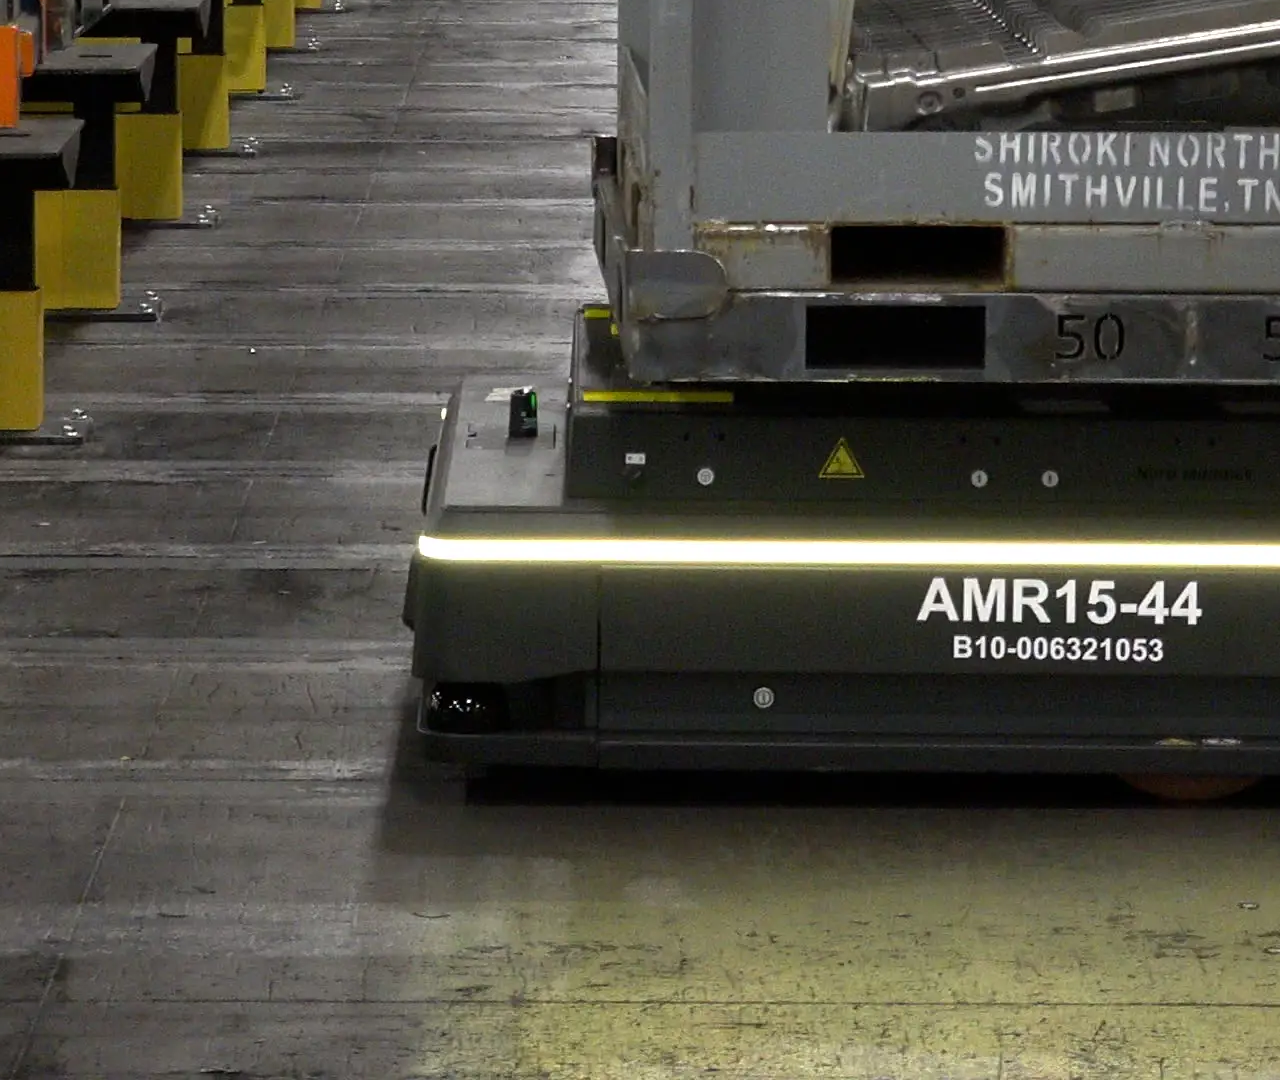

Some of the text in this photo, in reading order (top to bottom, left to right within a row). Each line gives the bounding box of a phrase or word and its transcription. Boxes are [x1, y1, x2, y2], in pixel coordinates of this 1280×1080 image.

[974, 133, 1132, 167] SHIROKI
[1148, 133, 1280, 171] NORTH
[1055, 312, 1126, 361] 50
[916, 576, 1203, 626] AMR15-44
[952, 635, 1165, 663] B10-006321053
